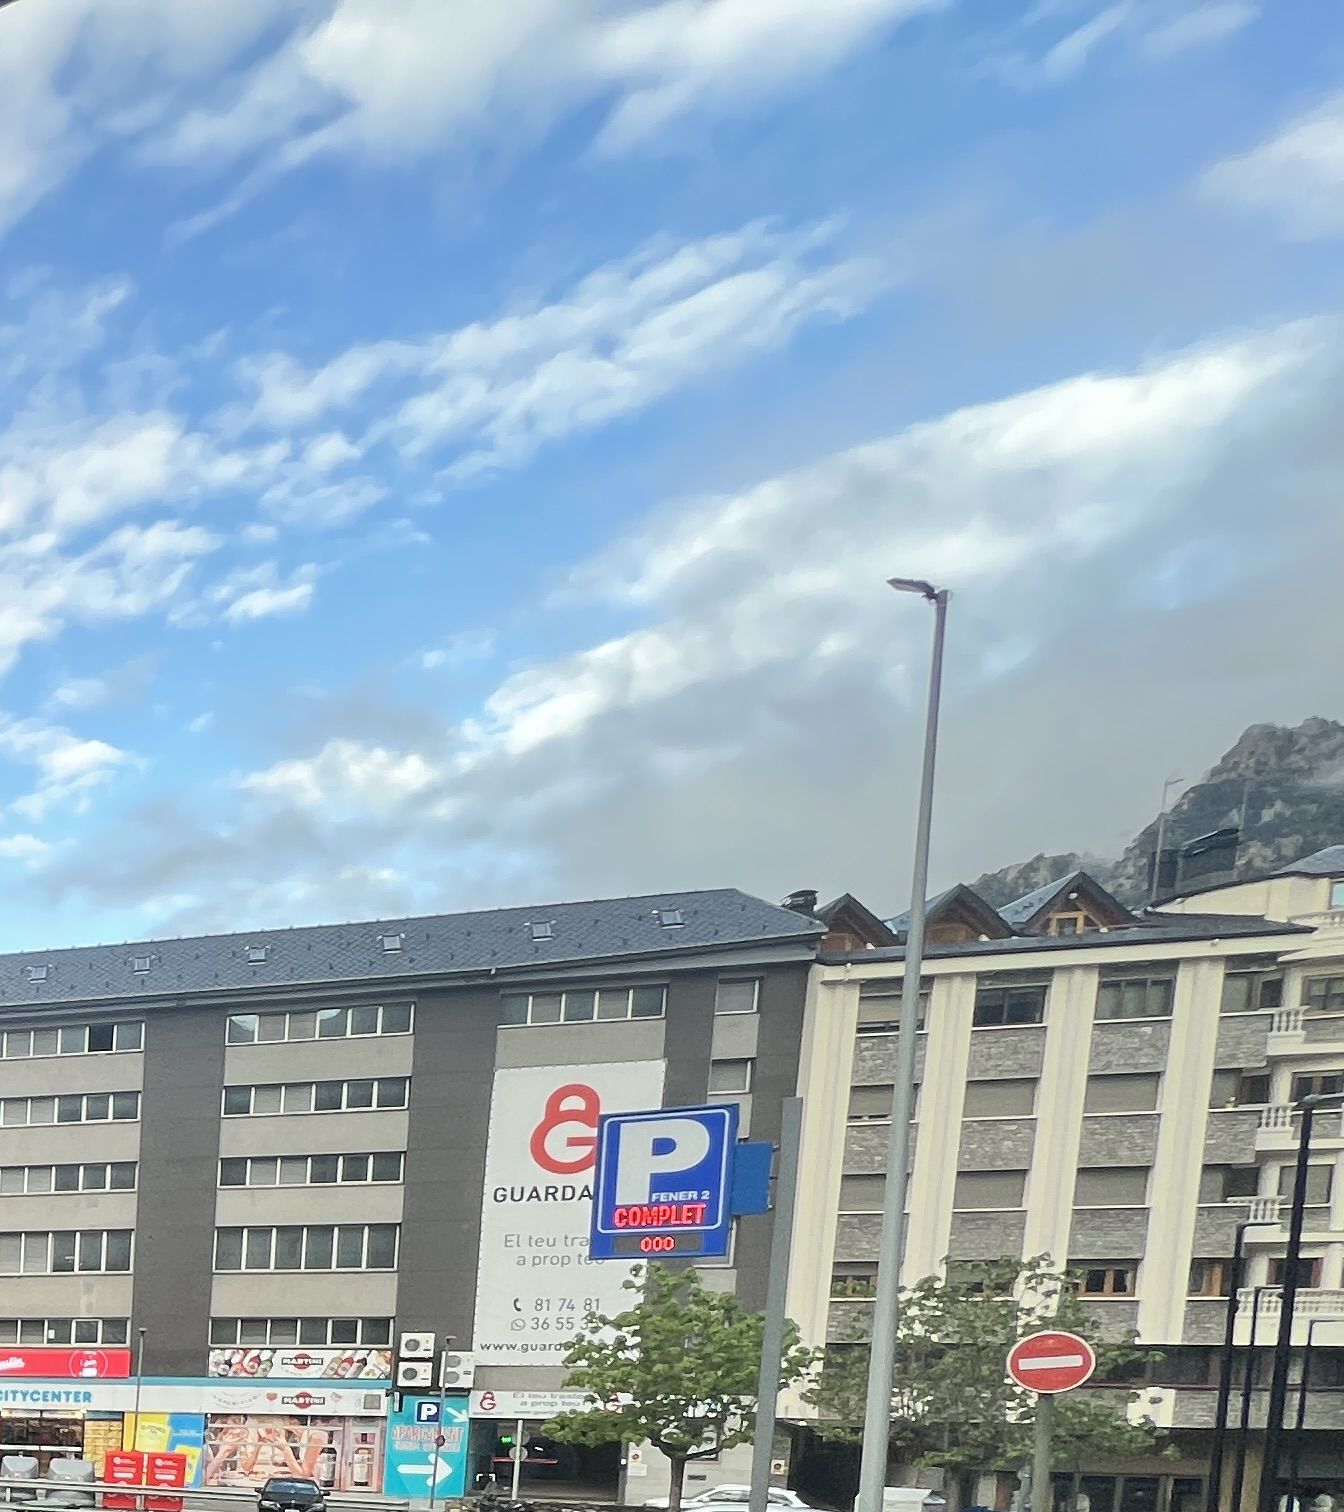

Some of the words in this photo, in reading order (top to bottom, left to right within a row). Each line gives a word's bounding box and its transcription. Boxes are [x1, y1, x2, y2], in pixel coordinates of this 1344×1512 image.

[651, 1190, 698, 1203] FENER
[700, 1190, 710, 1201] 2
[614, 1203, 707, 1228] COMPLET
[504, 1233, 521, 1248] El
[528, 1235, 556, 1248] teu
[564, 1234, 590, 1248] tra
[640, 1236, 675, 1252] 000
[516, 1255, 526, 1266] a
[532, 1254, 571, 1268] prop
[534, 1298, 551, 1312] 81
[558, 1298, 575, 1312] 74
[583, 1298, 600, 1312] 81
[530, 1317, 550, 1331] 36
[555, 1317, 574, 1331] 55
